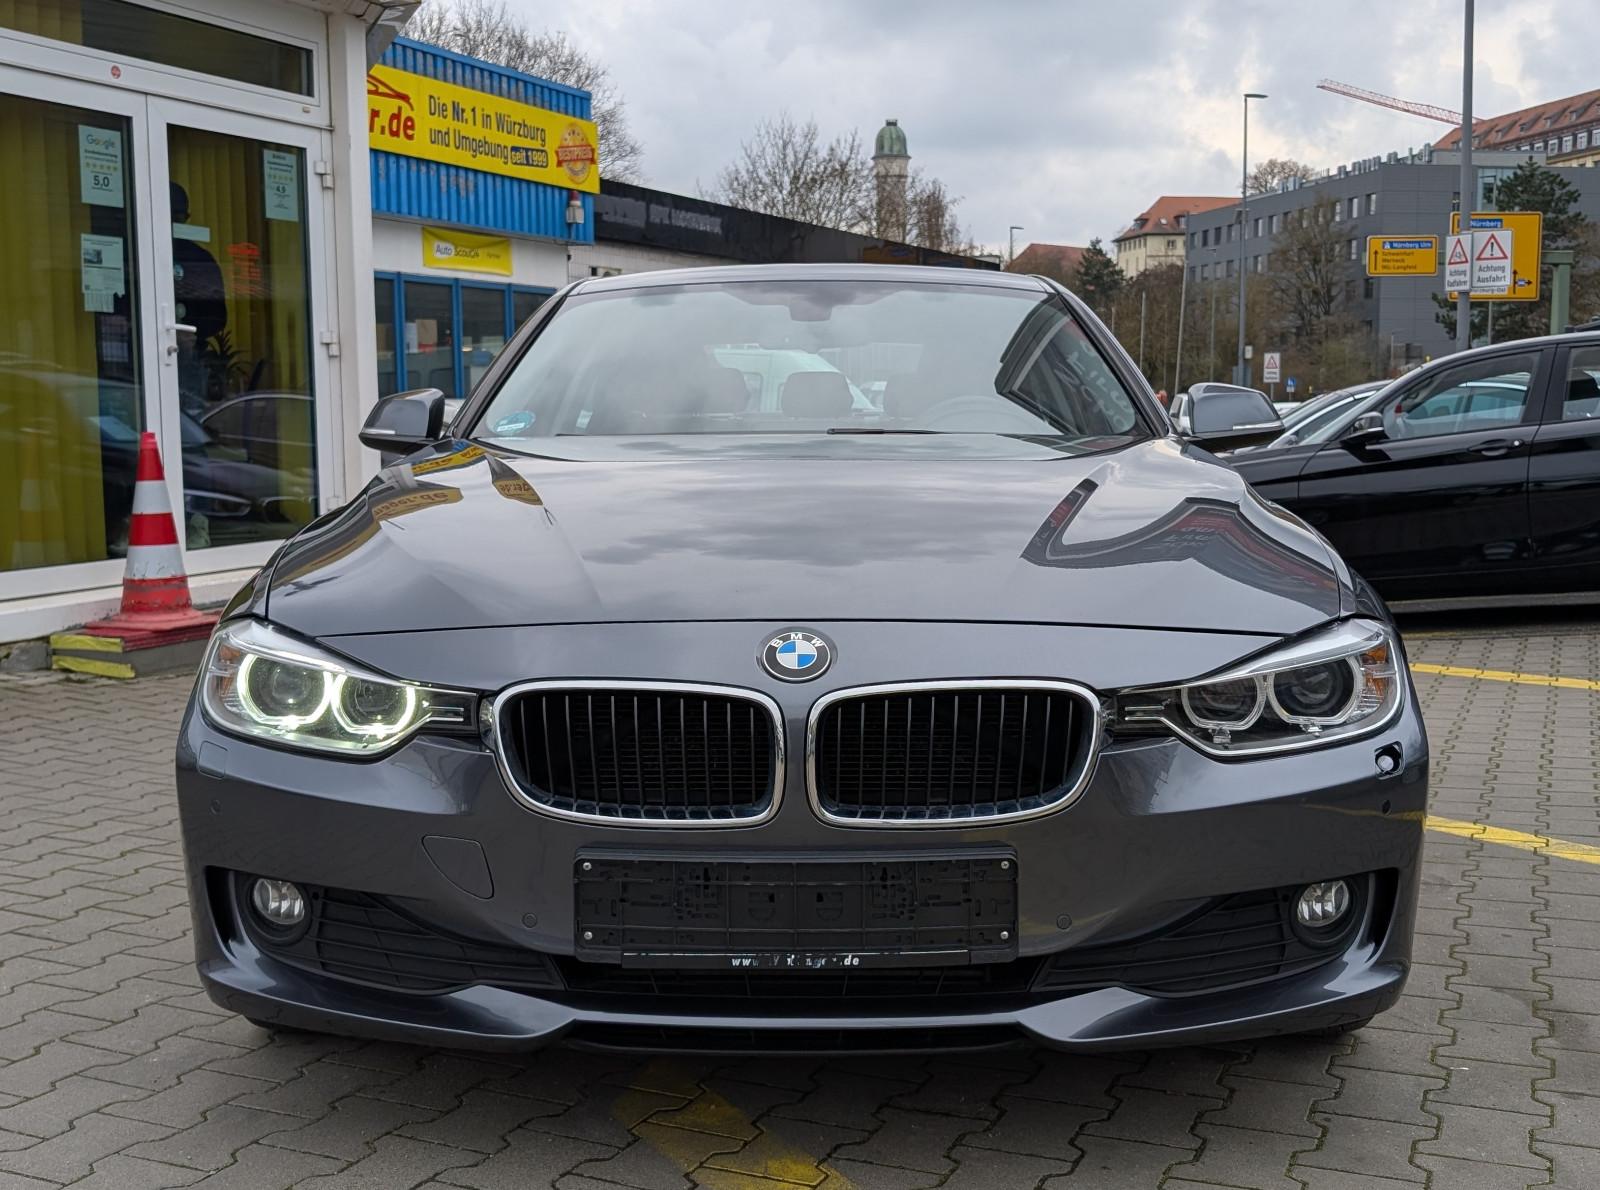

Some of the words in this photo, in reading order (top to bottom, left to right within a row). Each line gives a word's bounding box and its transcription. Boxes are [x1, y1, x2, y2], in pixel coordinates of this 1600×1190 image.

[428, 95, 448, 120] Die
[451, 101, 469, 125] Nr.
[470, 107, 478, 126] 1
[481, 109, 492, 130] in
[495, 111, 546, 147] Würzburg
[429, 127, 450, 147] und
[453, 131, 510, 164] Umgebung
[511, 149, 527, 166] seit
[528, 151, 548, 168] 1999
[93, 175, 110, 188] 5,0
[1470, 219, 1501, 229] Nürnberg
[1478, 264, 1506, 273] Achtung
[1476, 275, 1506, 283] Ausfahrt
[770, 633, 826, 648] BMW
